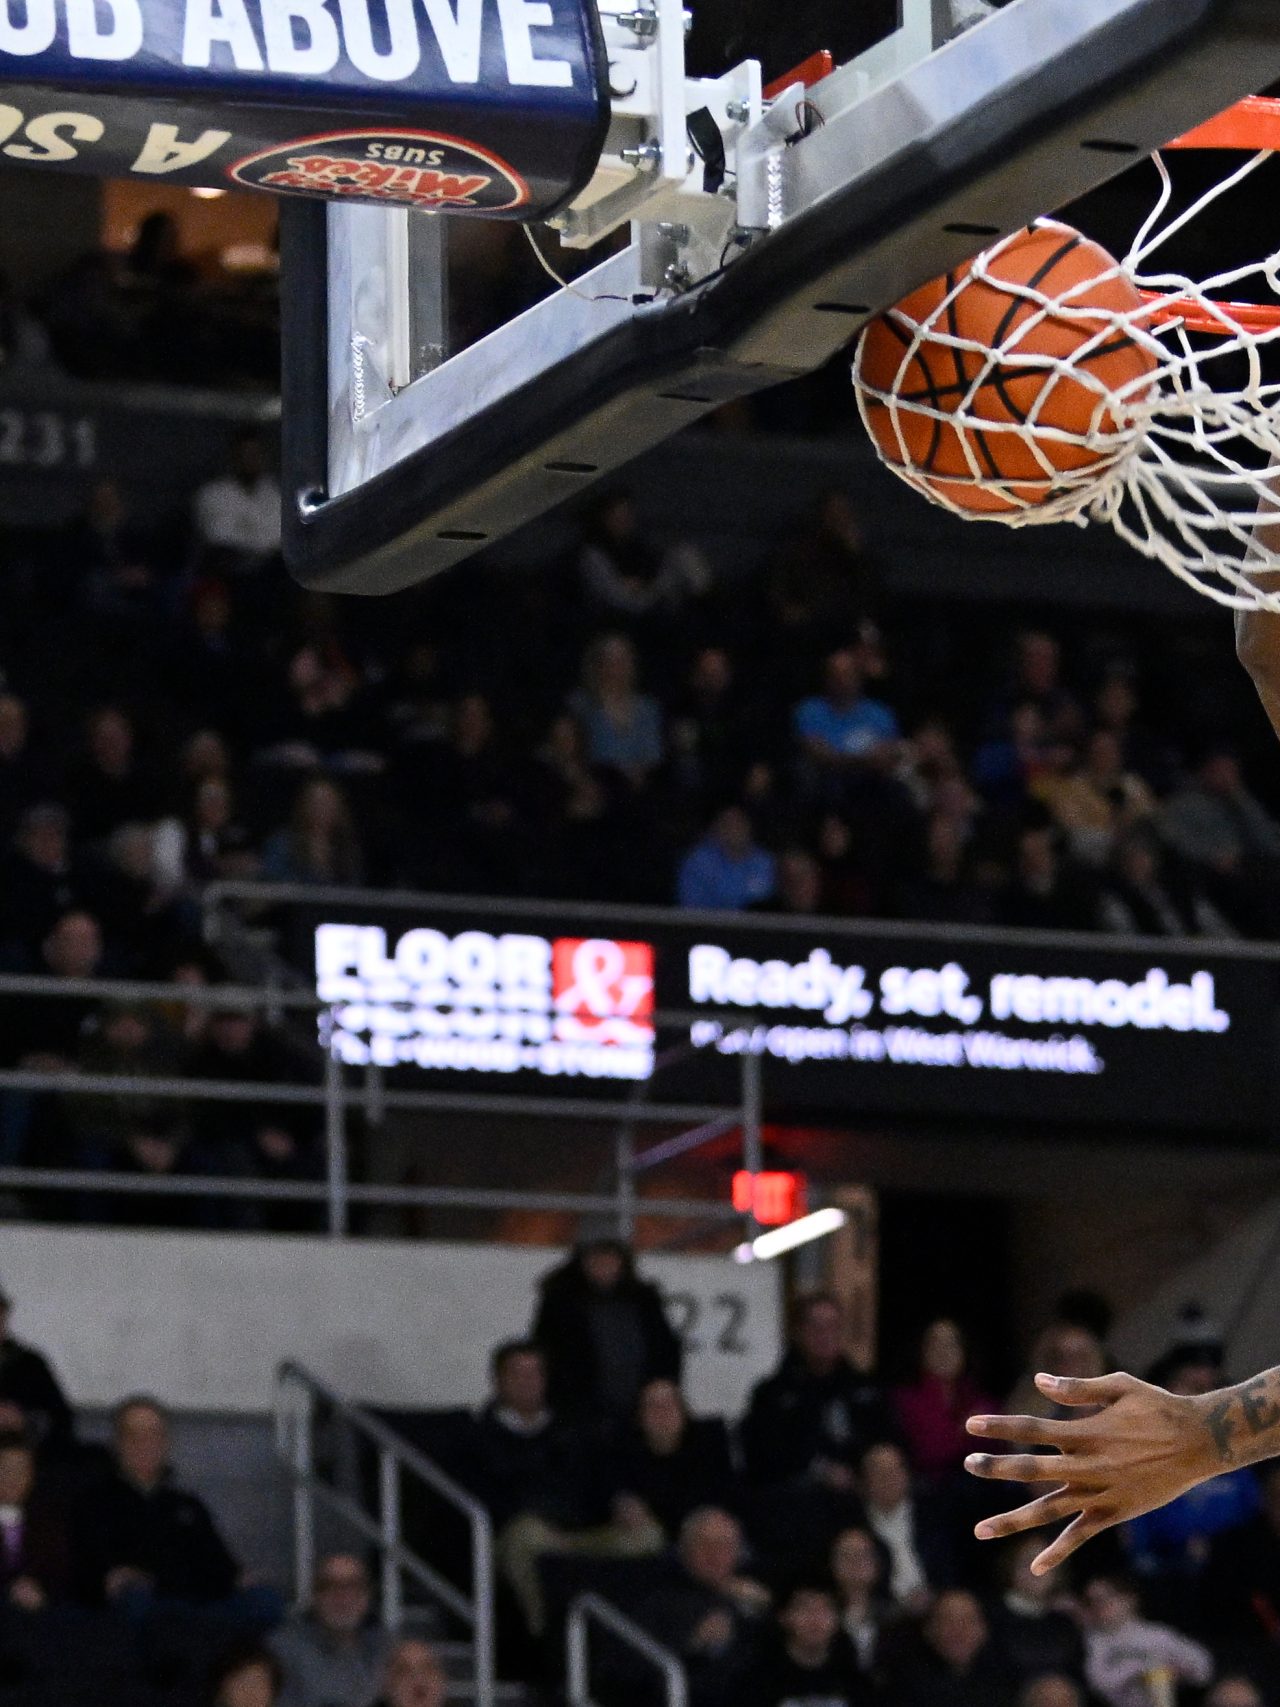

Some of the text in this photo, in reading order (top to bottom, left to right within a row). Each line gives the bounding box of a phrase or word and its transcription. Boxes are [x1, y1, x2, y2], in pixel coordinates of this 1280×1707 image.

[182, 0, 573, 87] ABOVE
[130, 122, 232, 174] A
[364, 142, 444, 166] SUBS
[315, 923, 552, 990] FLOOR
[689, 944, 1230, 1034] Ready, set, remodel.
